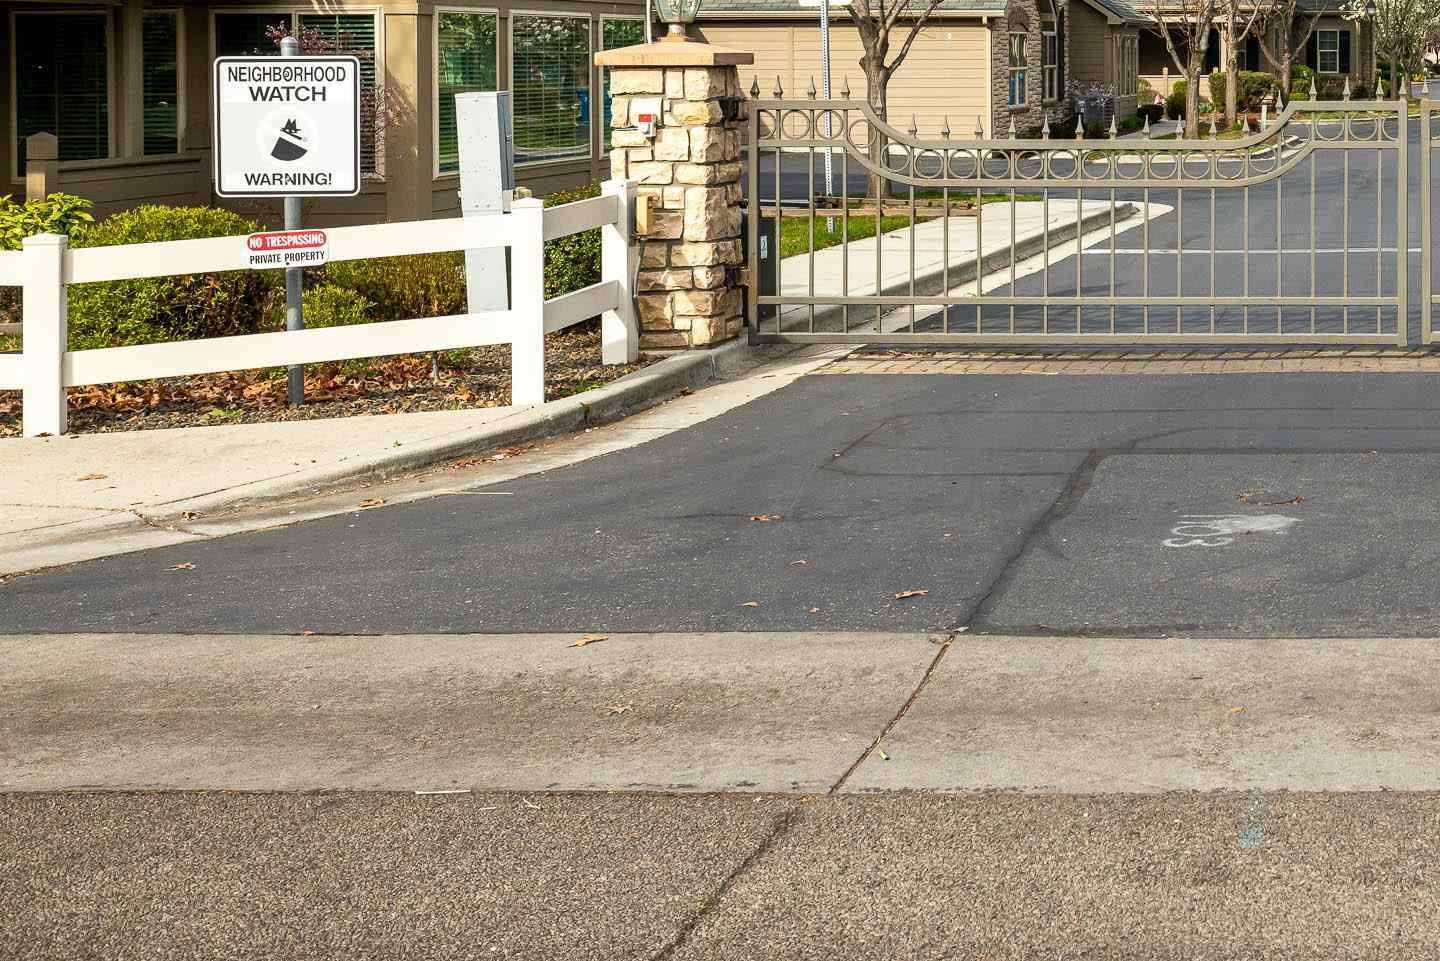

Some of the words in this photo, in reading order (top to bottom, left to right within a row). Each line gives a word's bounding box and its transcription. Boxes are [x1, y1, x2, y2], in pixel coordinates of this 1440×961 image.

[228, 66, 346, 82] NEIGHBORHOOD
[248, 86, 327, 102] WATCH
[244, 172, 332, 186] WARNING!
[249, 237, 263, 249] NO
[265, 233, 324, 248] TRESPASSING
[249, 253, 282, 265] PRIVATE
[284, 250, 325, 263] PROPERTY
